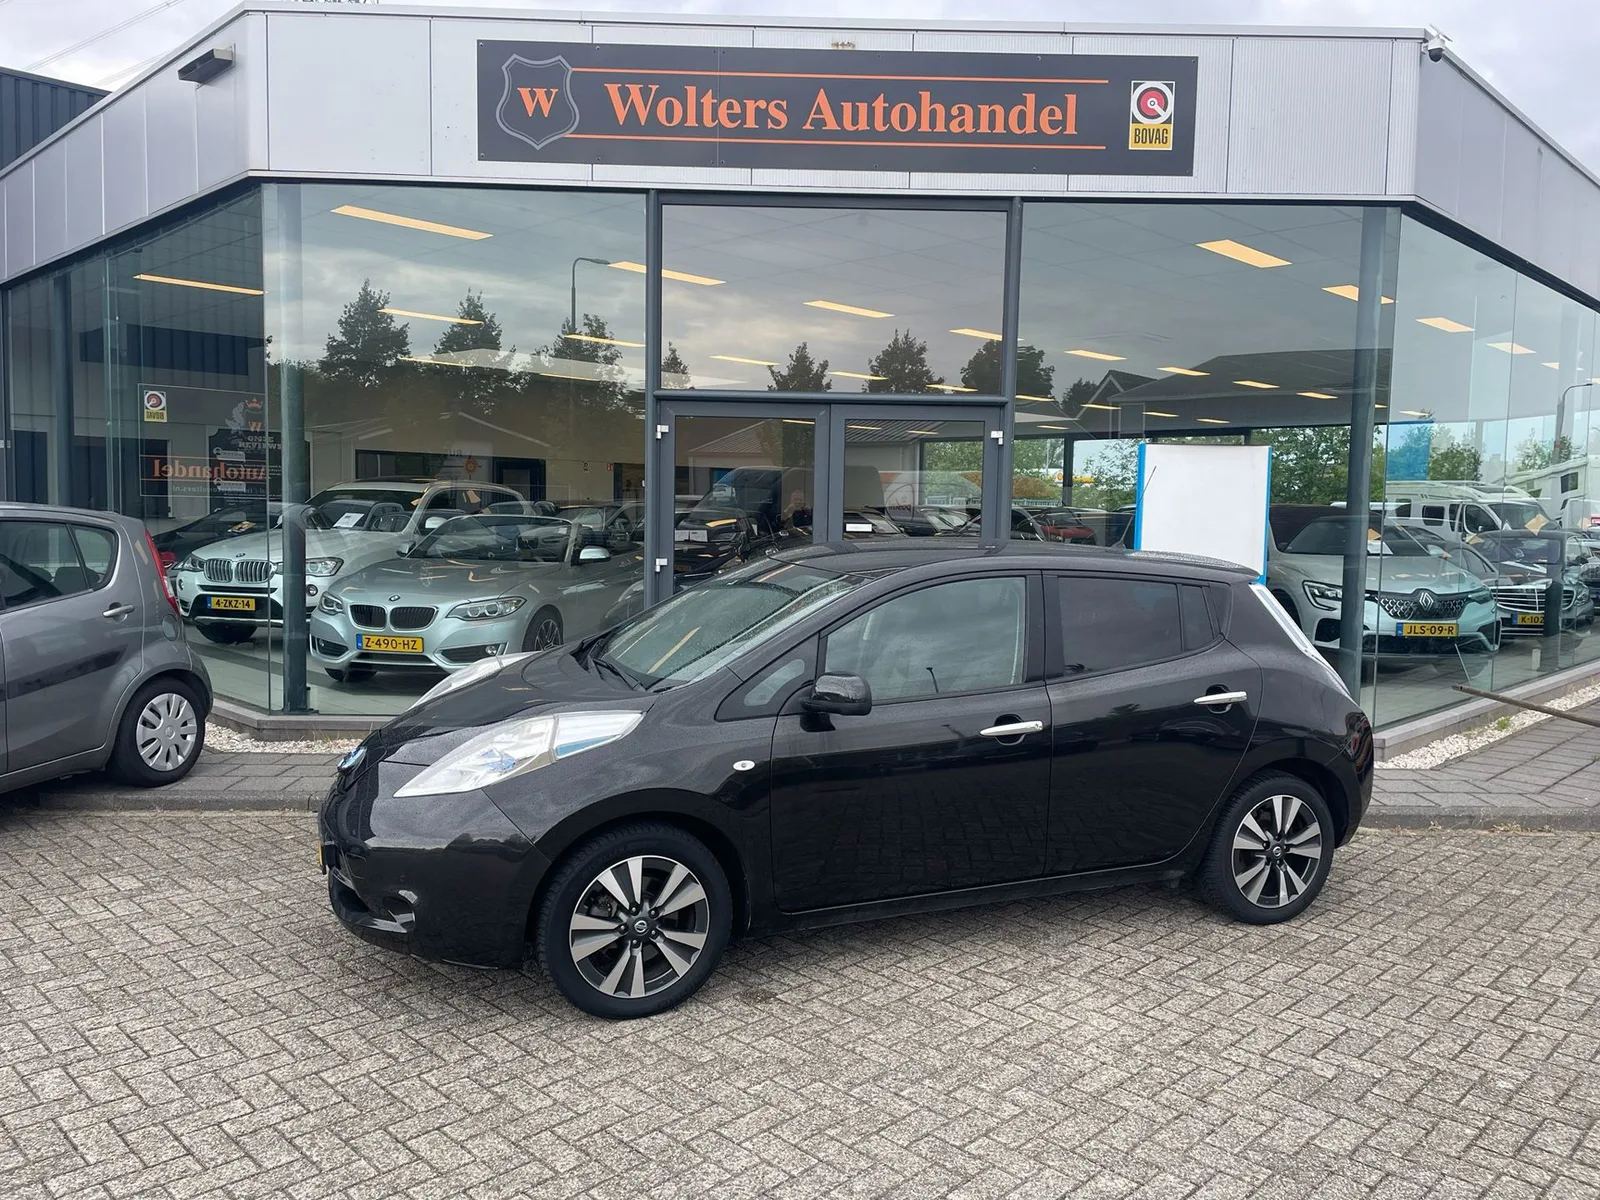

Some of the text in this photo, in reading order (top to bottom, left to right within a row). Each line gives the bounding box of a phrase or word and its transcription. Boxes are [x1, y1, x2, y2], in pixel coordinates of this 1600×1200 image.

[517, 87, 559, 118] W
[604, 82, 1078, 135] Wolters Autohandel
[1134, 128, 1168, 144] BOVAG
[215, 598, 251, 609] 4-ZKZ-14
[1407, 625, 1454, 635] JLS-09-R
[364, 637, 418, 650] Z-490-HZ
